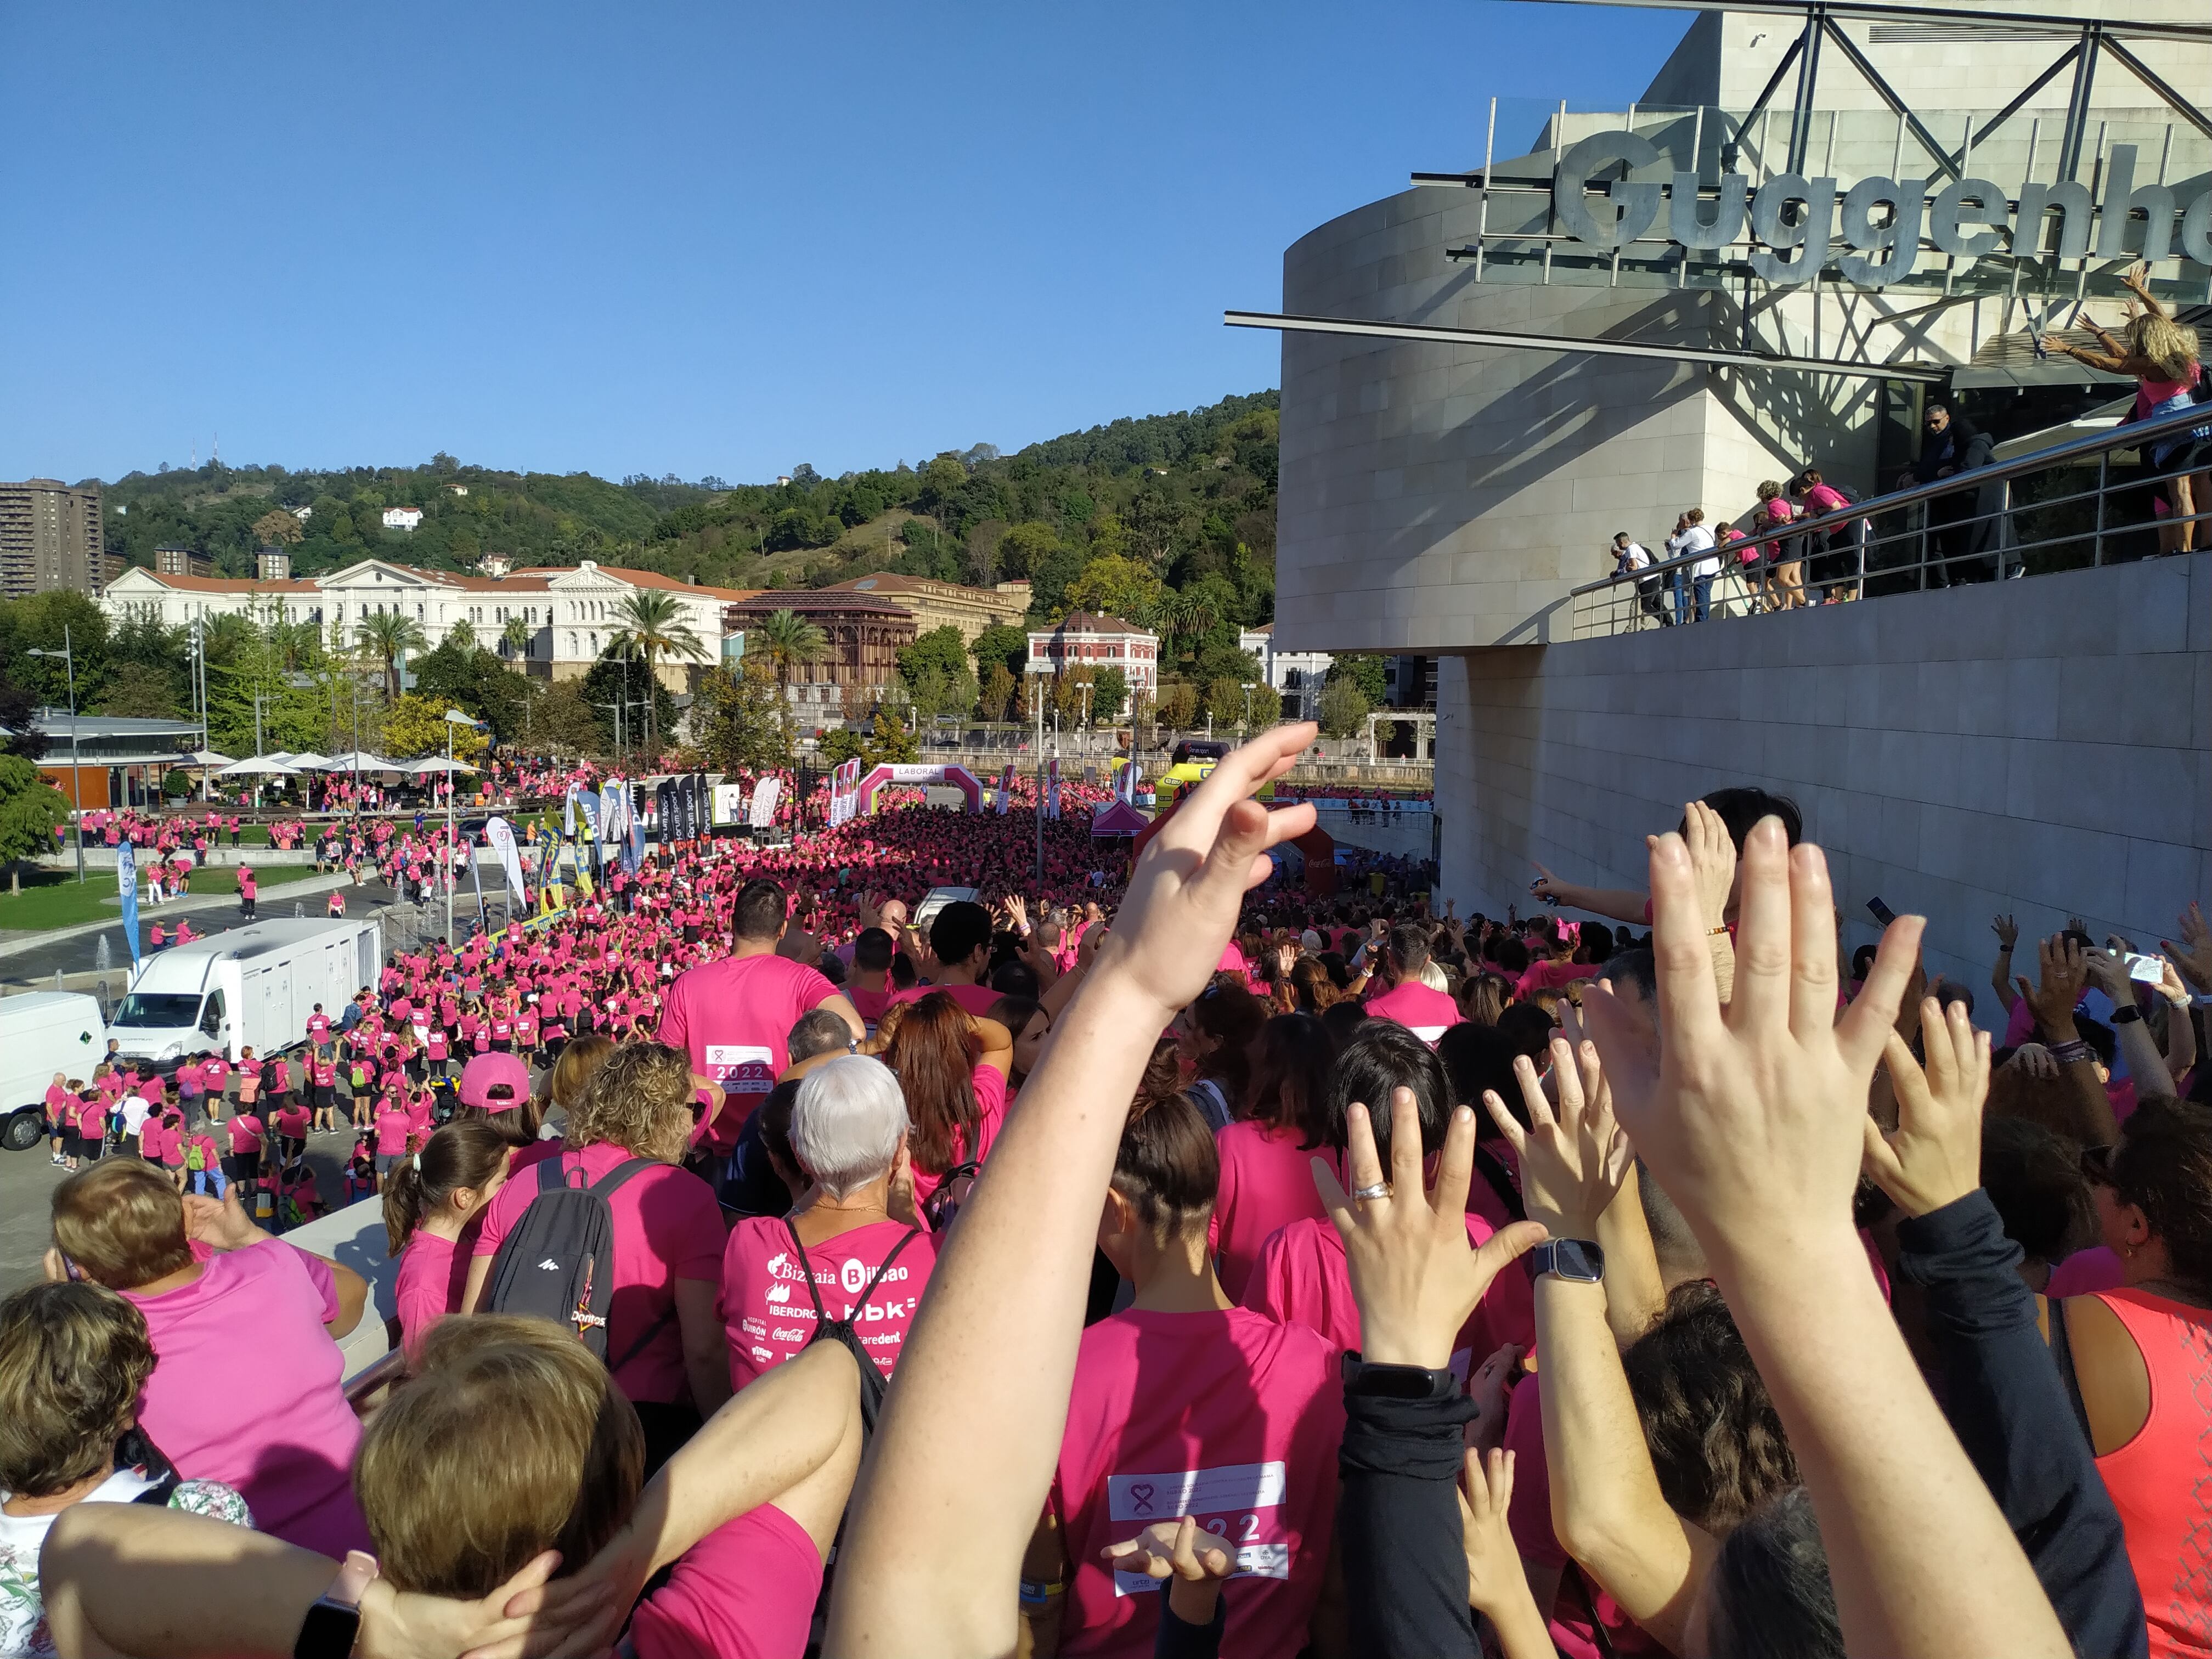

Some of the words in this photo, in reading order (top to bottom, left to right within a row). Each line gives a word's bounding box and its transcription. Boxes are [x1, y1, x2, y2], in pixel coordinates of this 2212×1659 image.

[670, 791, 680, 813] sport
[686, 789, 695, 811] sport
[582, 803, 600, 837] Deia
[717, 1066, 763, 1079] 2022
[781, 1262, 837, 1284] Bizaia
[571, 1311, 607, 1327] Doritos
[769, 1305, 833, 1320] IBERDROA
